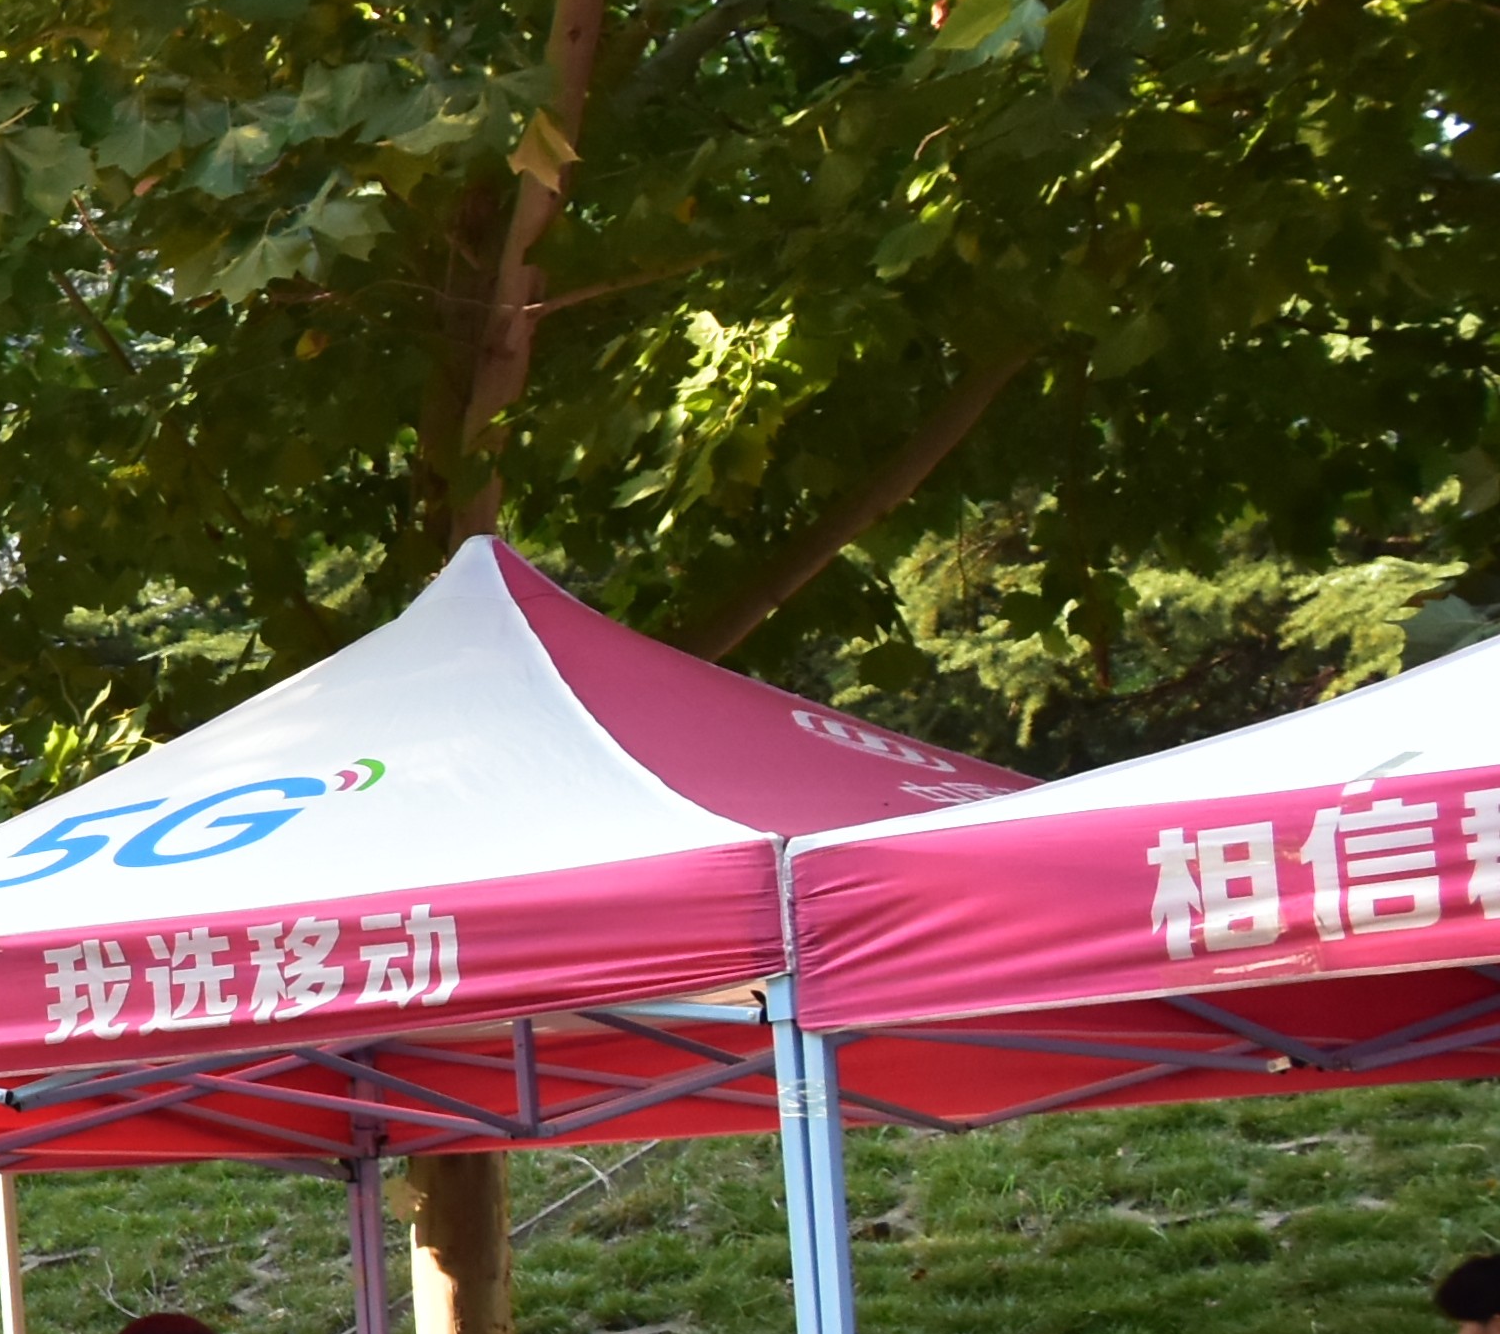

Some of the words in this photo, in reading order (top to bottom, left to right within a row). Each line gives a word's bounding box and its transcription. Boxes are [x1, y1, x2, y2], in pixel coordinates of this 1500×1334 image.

[1147, 778, 1500, 960] 相信
[44, 903, 461, 1046] 我选移动
